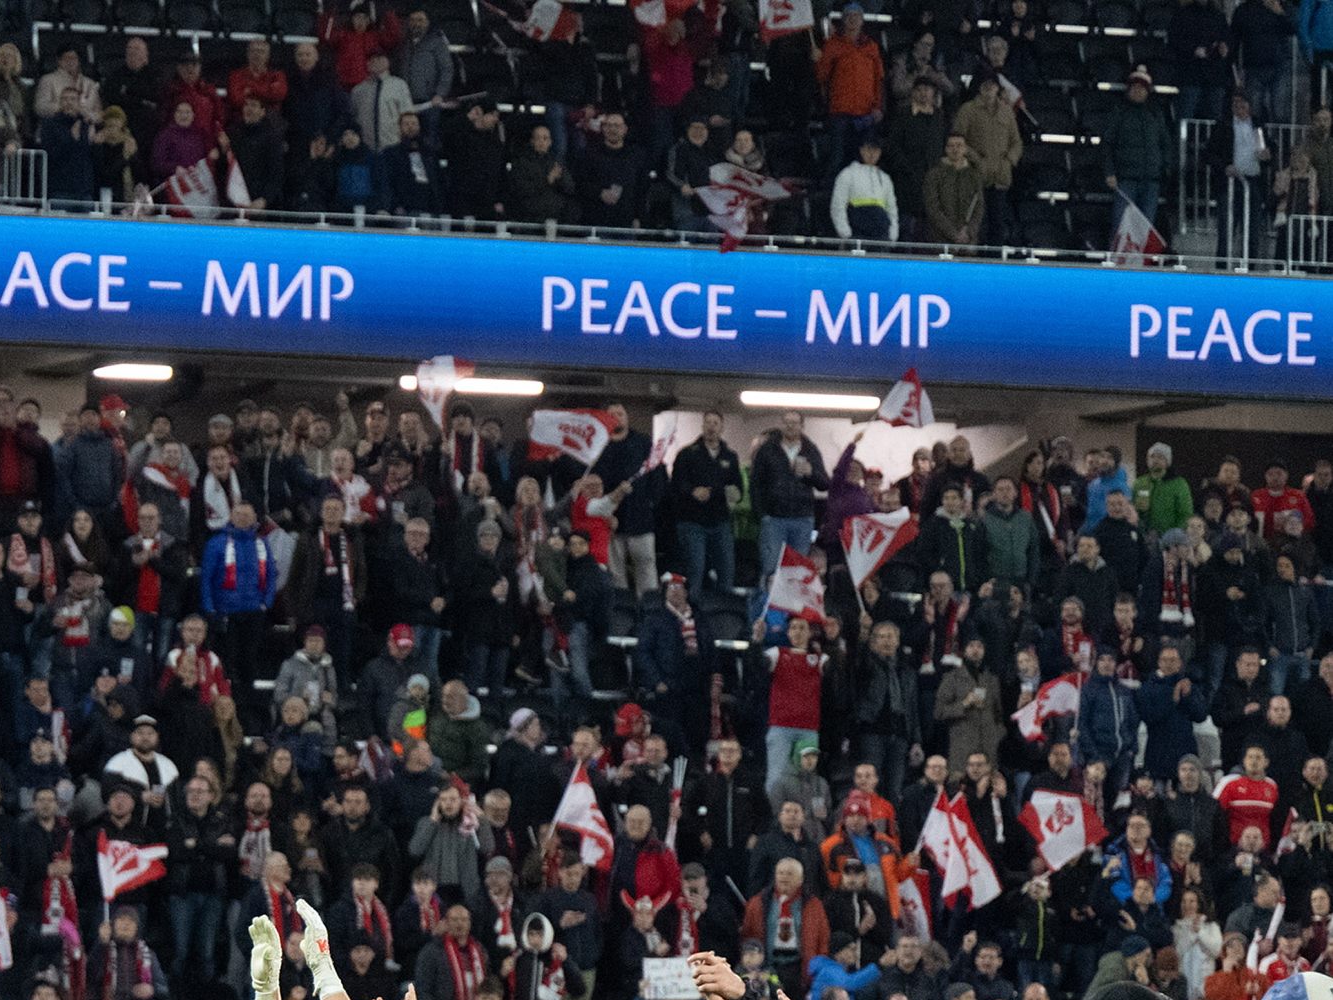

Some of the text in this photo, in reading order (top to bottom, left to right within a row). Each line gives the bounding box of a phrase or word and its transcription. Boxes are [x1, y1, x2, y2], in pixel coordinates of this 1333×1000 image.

[202, 260, 354, 320] МИР
[542, 276, 738, 339] PEACE
[805, 289, 951, 348] МИР
[1130, 304, 1316, 365] PEACE
